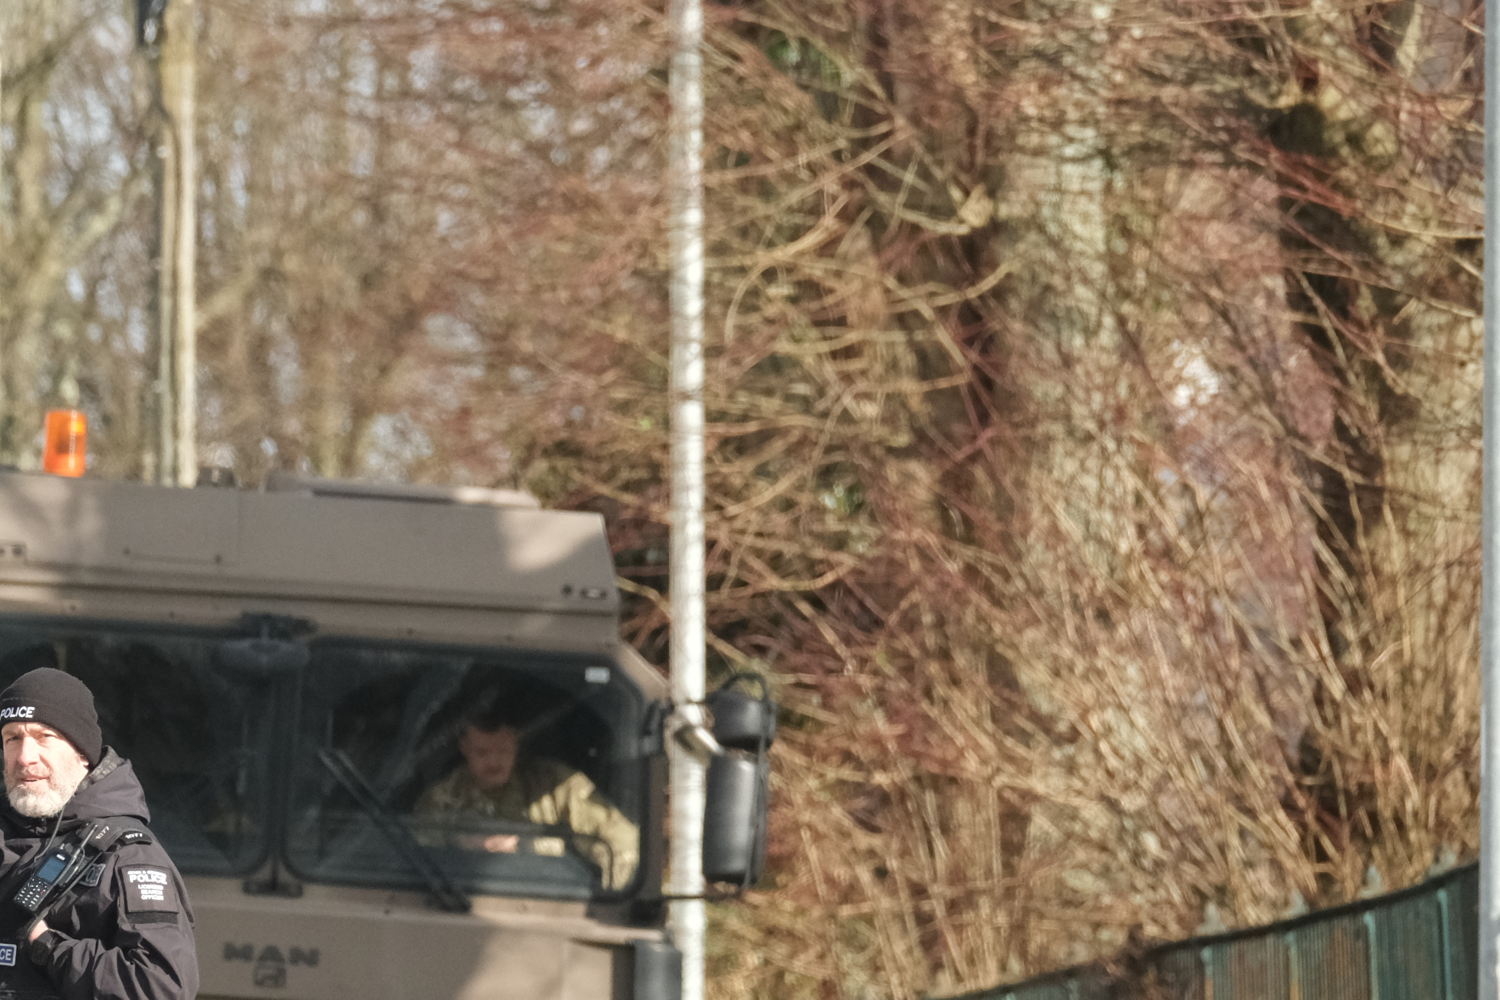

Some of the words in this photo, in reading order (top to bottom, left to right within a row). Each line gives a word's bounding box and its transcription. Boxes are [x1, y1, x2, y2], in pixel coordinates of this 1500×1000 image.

[0, 705, 35, 721] POLICE
[129, 873, 168, 885] POLICE
[224, 942, 320, 967] MAN
